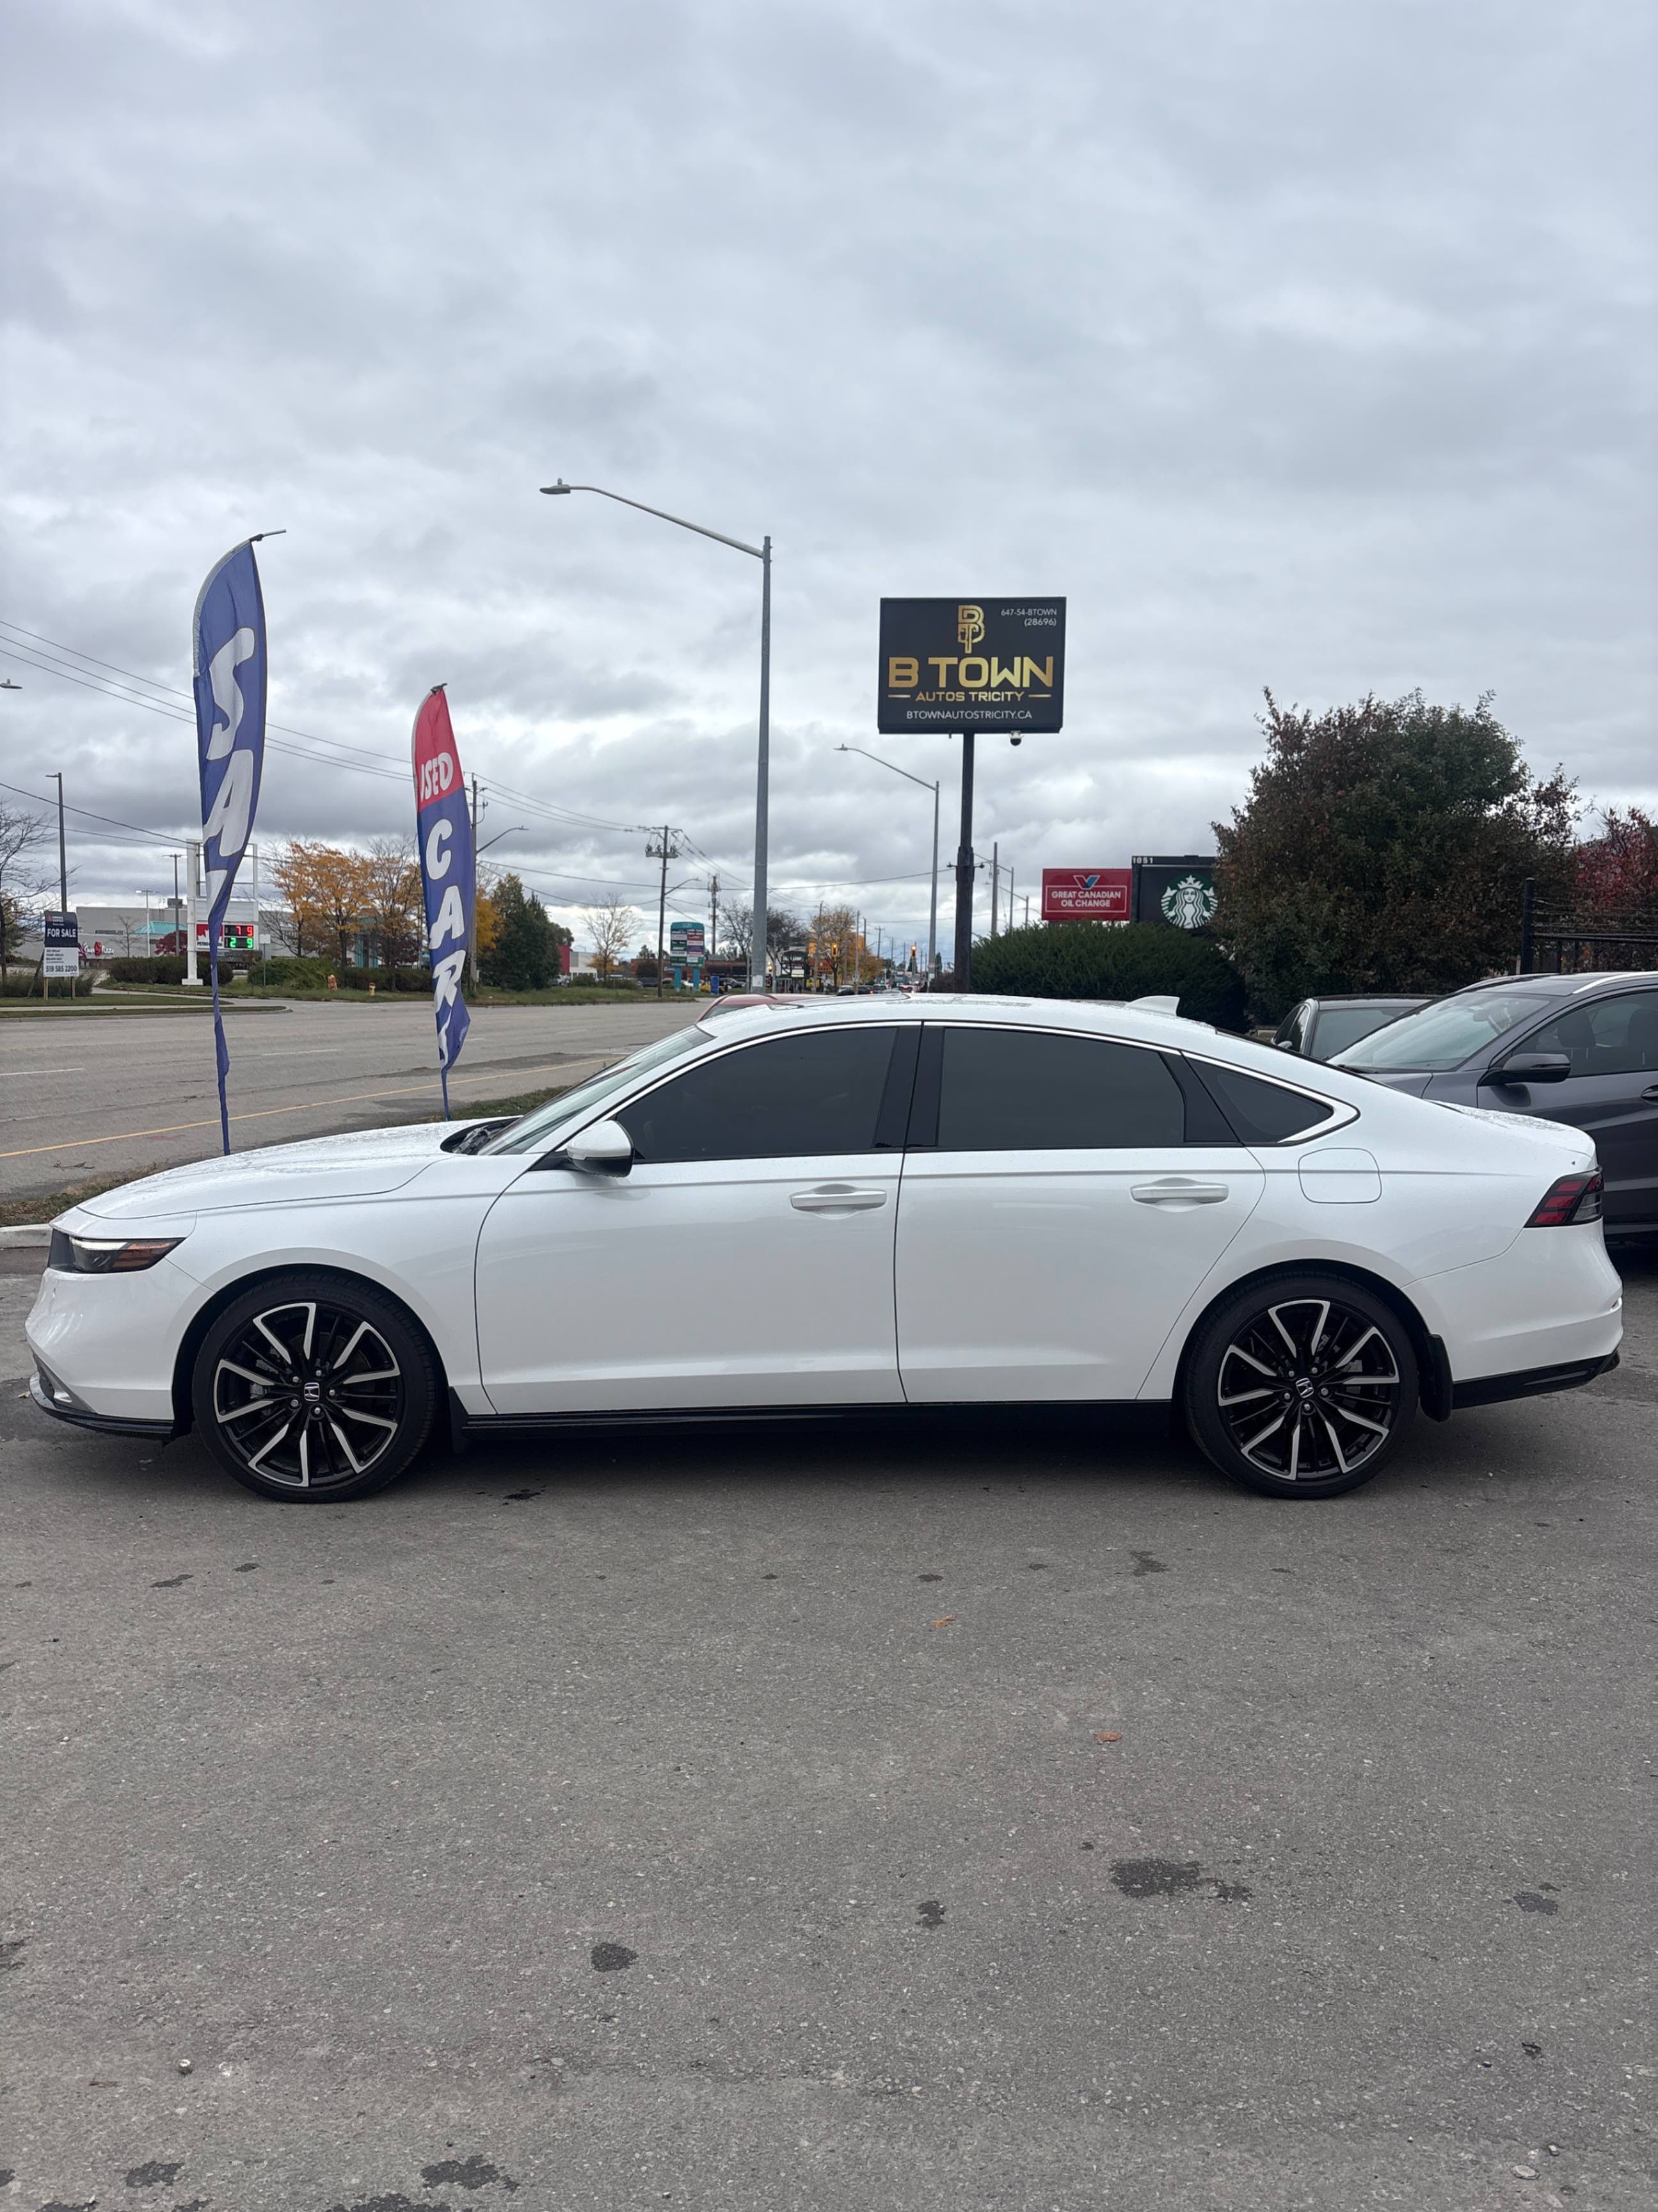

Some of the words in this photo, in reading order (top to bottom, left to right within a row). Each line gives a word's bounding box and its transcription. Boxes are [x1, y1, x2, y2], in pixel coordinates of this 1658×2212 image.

[1024, 618, 1056, 627] (28696)
[889, 657, 919, 687] B
[928, 656, 1053, 687] TOWN
[916, 692, 965, 701] AUTOS
[969, 691, 1024, 701] TRICITY
[907, 710, 1032, 719] BTOWNAUTOSTRICITY.CA
[47, 928, 60, 937] FOR
[61, 928, 76, 937] SALE
